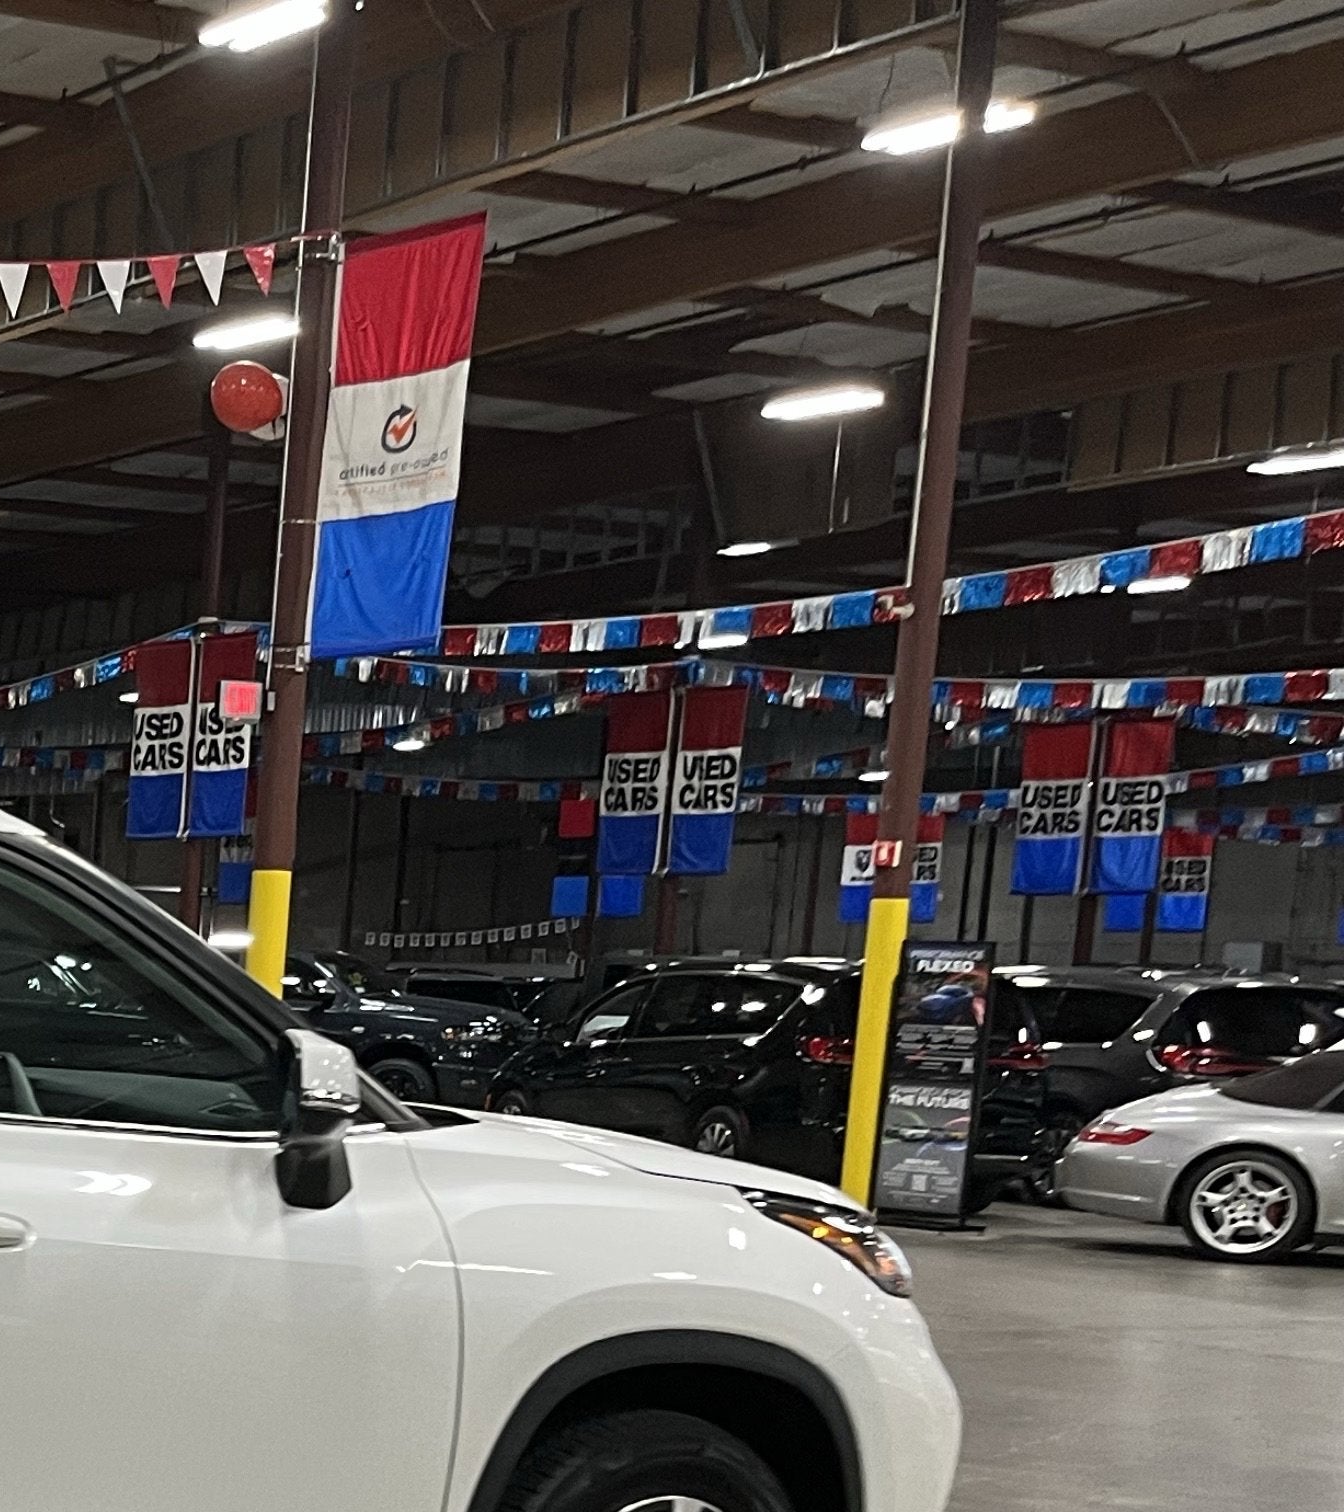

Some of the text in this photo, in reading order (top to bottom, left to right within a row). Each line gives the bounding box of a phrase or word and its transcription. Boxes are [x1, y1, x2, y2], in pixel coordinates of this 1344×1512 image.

[339, 448, 449, 480] ctified pre-owed
[135, 711, 185, 741] USED
[199, 707, 245, 735] US
[134, 742, 184, 771] CARS
[195, 735, 245, 766] CARS
[607, 756, 661, 783] USED
[605, 786, 658, 812] CARS
[679, 783, 735, 809] CARS
[1021, 783, 1083, 808] USED
[1102, 781, 1163, 806] USED
[1019, 810, 1081, 834] CARS
[1096, 807, 1160, 832] CARS
[914, 846, 938, 862] ED
[916, 865, 937, 881] RS
